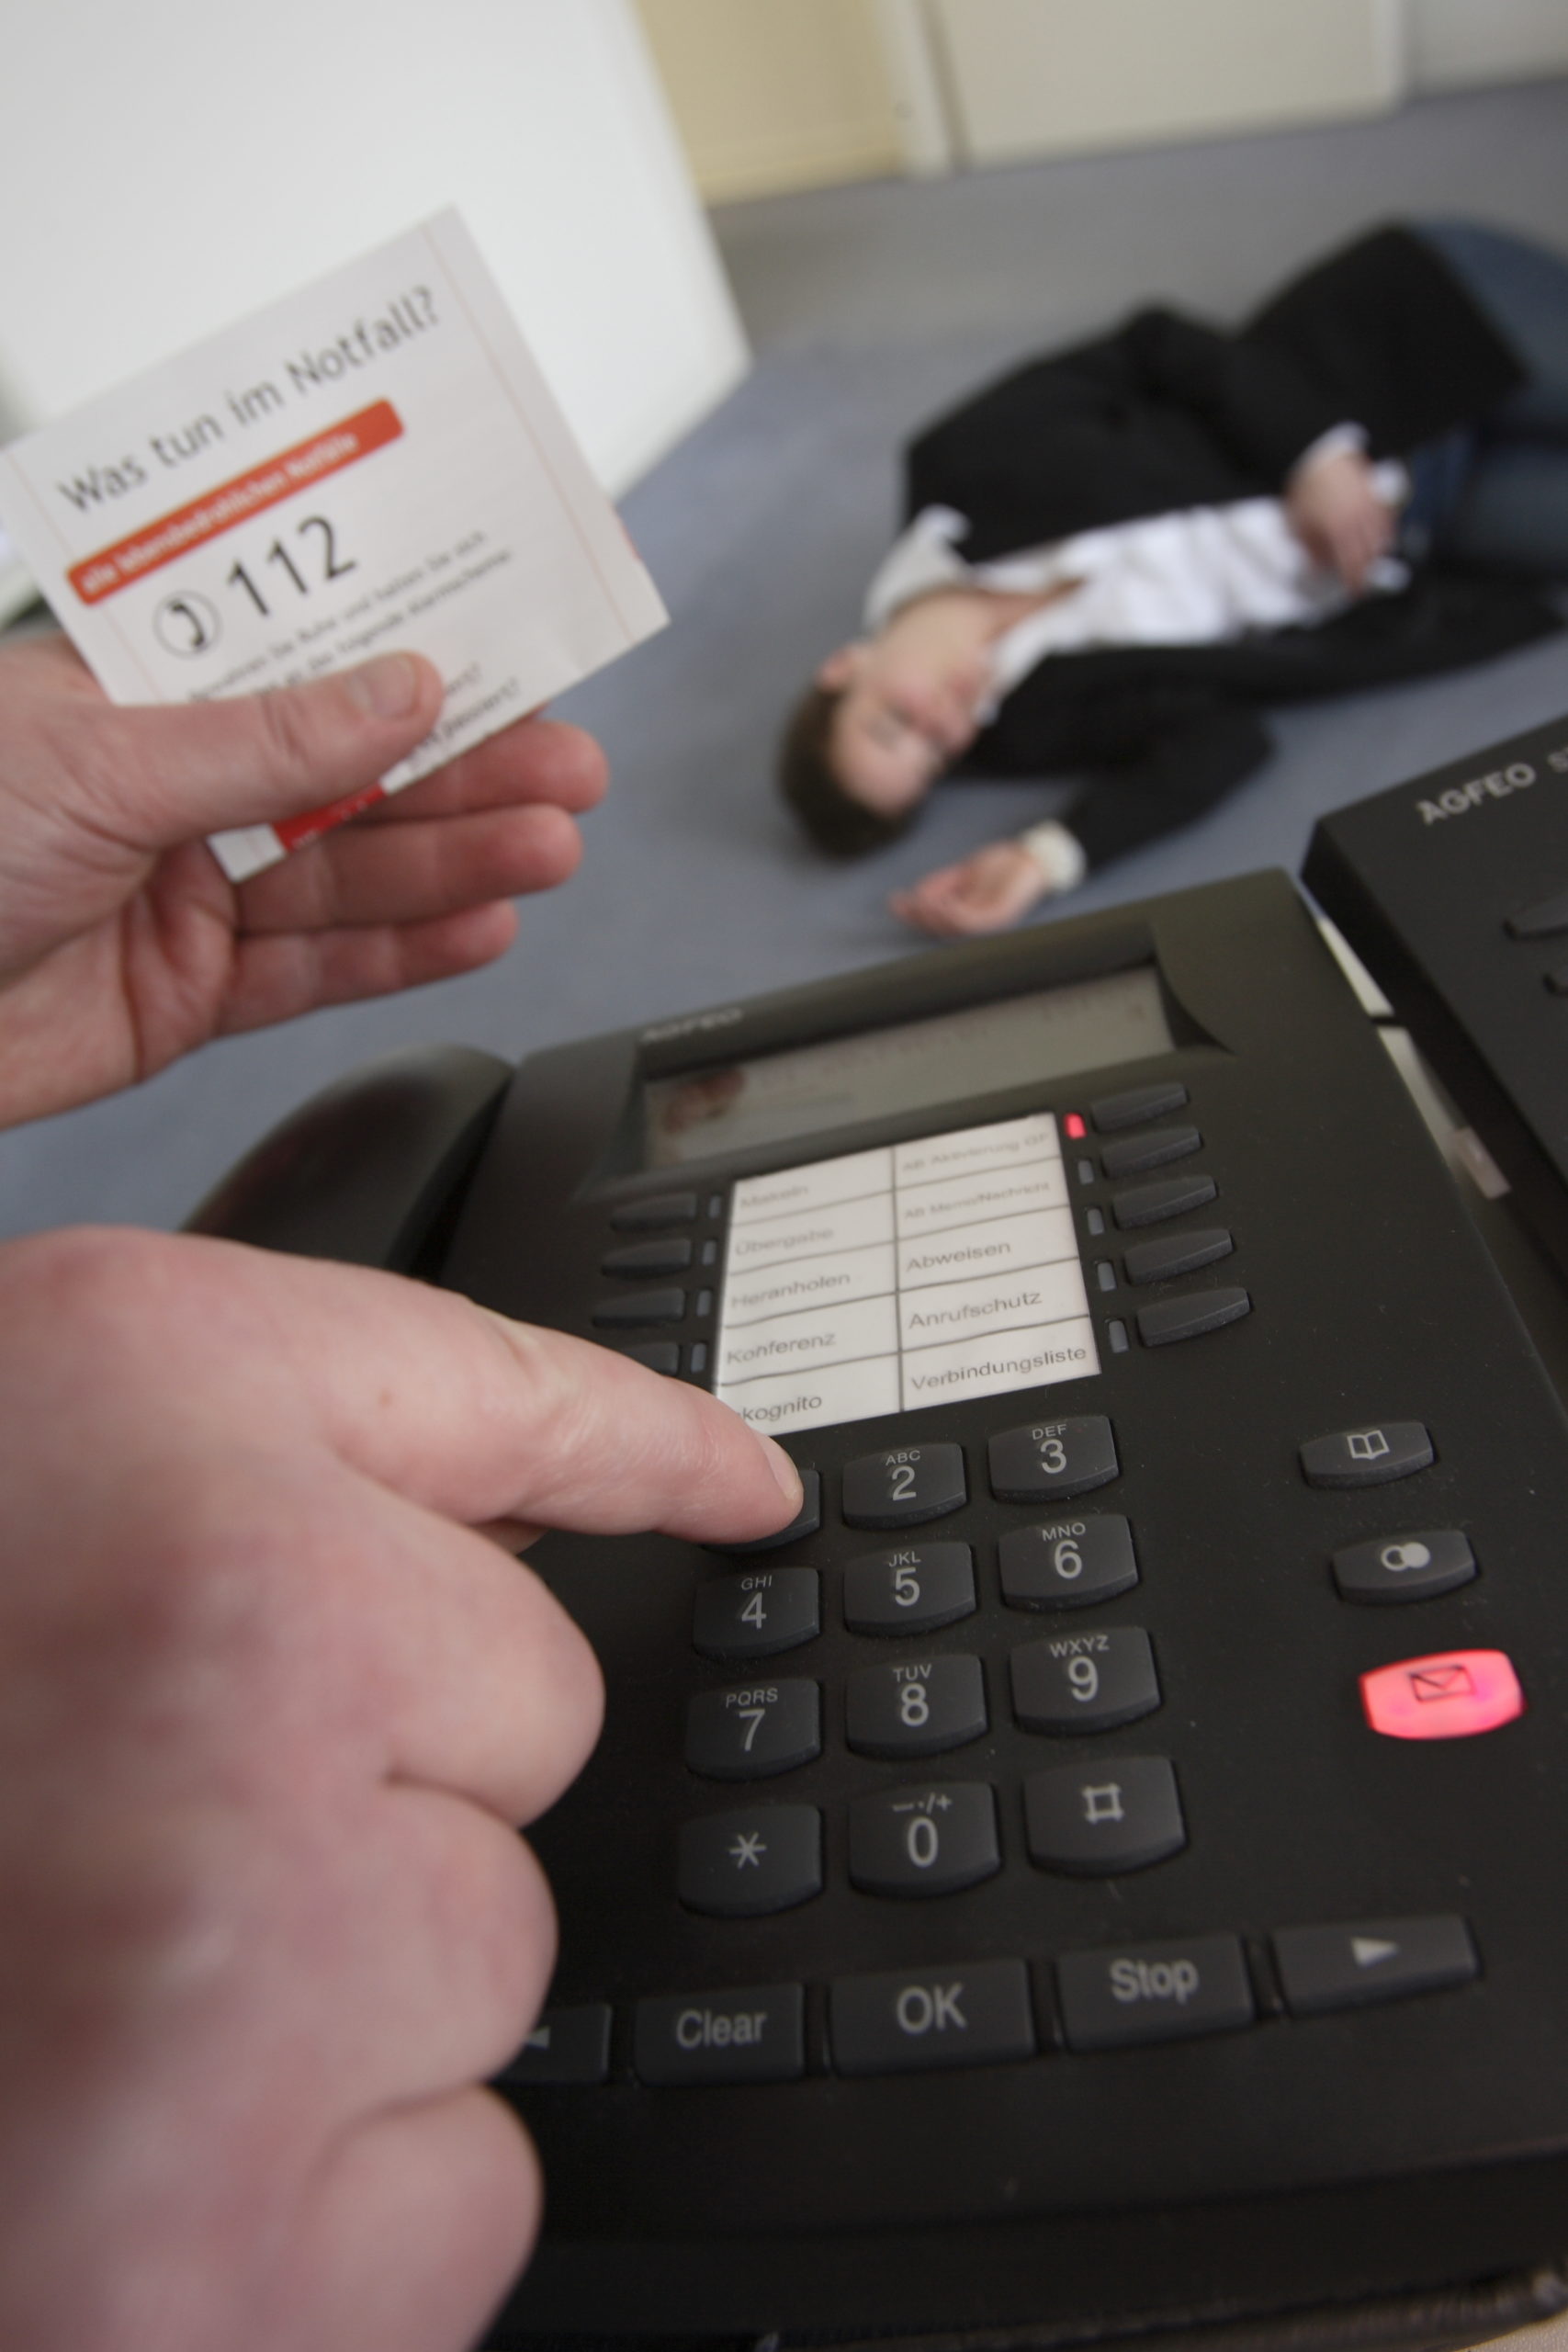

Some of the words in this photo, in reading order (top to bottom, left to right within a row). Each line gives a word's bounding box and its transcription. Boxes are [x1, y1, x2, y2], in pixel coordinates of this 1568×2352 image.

[57, 456, 148, 512] Was
[148, 413, 226, 469] tun
[225, 379, 286, 425] im
[283, 284, 439, 395] Notfall?
[228, 515, 356, 616] 112
[1416, 762, 1536, 825] AGFEO
[735, 1225, 834, 1256] Übergabe
[905, 1241, 1011, 1272] Abweisen
[731, 1272, 851, 1308] Heranholen
[908, 1291, 1043, 1330] Anrufschutz
[727, 1331, 836, 1364] Konferenz
[911, 1346, 1087, 1390] Verbindungsliste
[1032, 1424, 1066, 1442] DEF
[886, 1449, 921, 1465] ABC
[1040, 1440, 1067, 1475] 3
[890, 1467, 917, 1501] 2
[1043, 1522, 1086, 1541] MNO
[889, 1551, 920, 1567] JKL
[1054, 1541, 1083, 1579] 6
[741, 1576, 772, 1589] GHI
[896, 1568, 919, 1606] 5
[741, 1592, 766, 1628] 4
[1050, 1634, 1109, 1659] WXYZ
[893, 1664, 931, 1681] TUV
[1068, 1657, 1098, 1701] 9
[727, 1688, 778, 1708] PQRS
[901, 1683, 929, 1725] 8
[739, 1710, 765, 1751] 7
[908, 1817, 938, 1866] 0
[1111, 1960, 1198, 2002] Stop
[897, 1984, 965, 2032] OK
[677, 2010, 766, 2048] Clear
